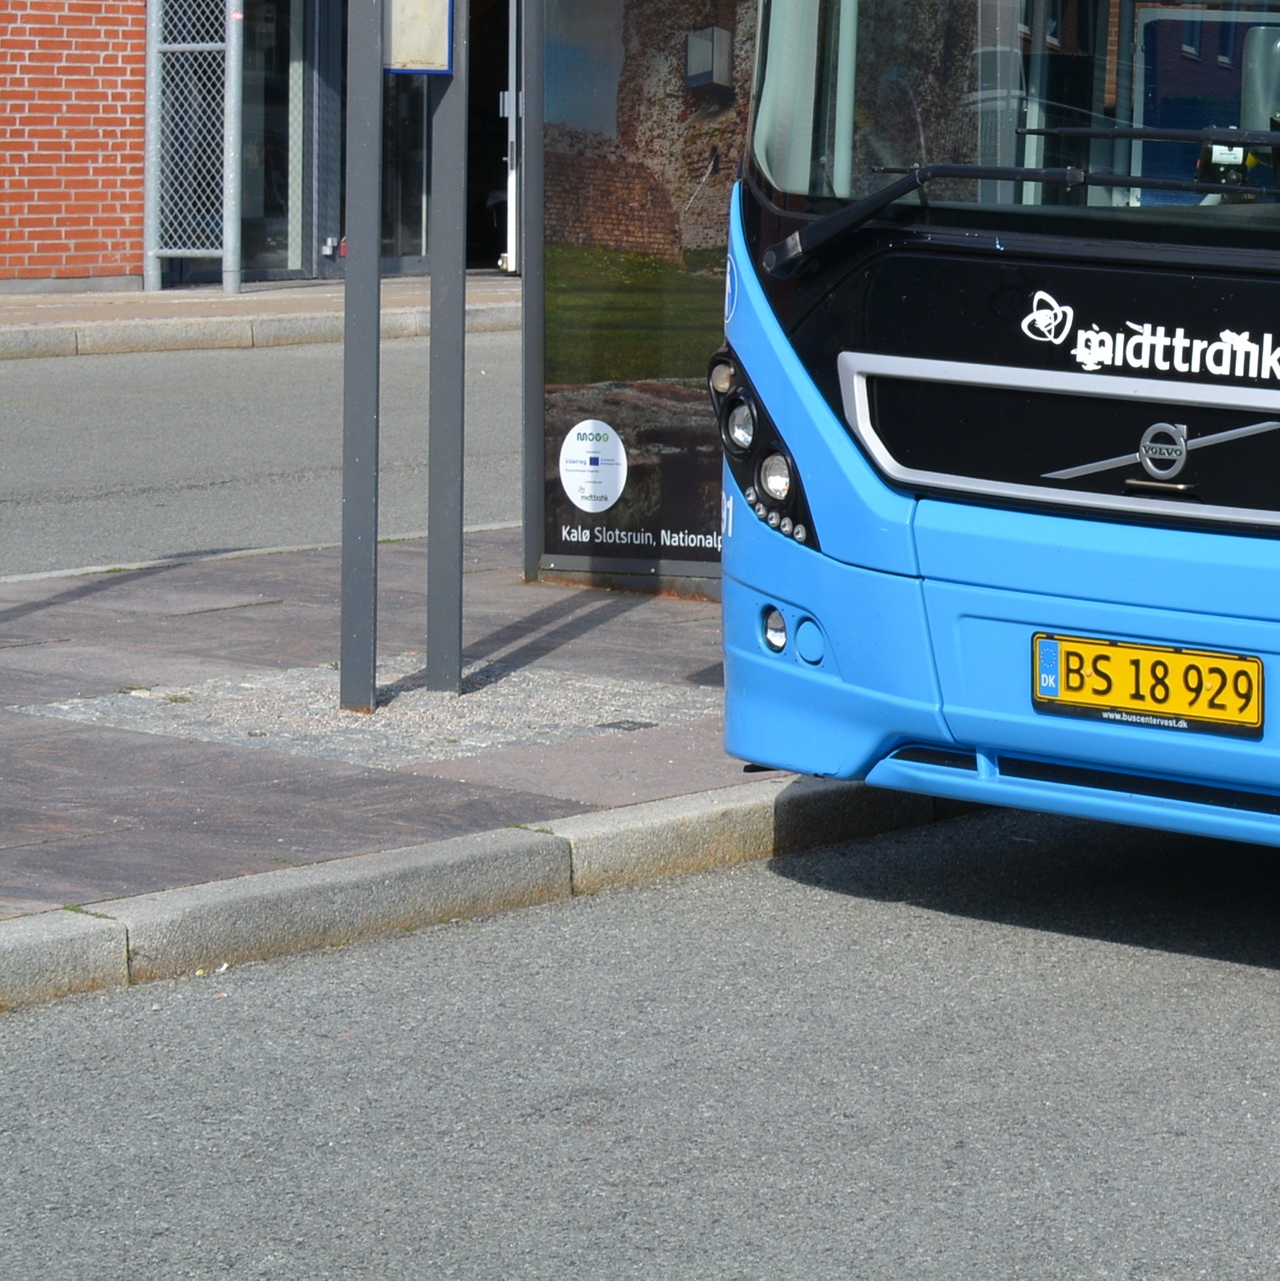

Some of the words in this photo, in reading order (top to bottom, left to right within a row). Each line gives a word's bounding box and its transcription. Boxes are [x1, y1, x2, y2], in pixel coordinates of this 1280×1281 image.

[1142, 445, 1183, 458] VOLVO
[561, 525, 591, 543] Kalø
[594, 526, 657, 547] Slotsruin,
[1041, 673, 1056, 689] DK
[1065, 650, 1113, 697] BS
[1128, 658, 1171, 705] 18
[1183, 663, 1254, 715] 929
[1101, 709, 1189, 730] www.buscentervest.dk
